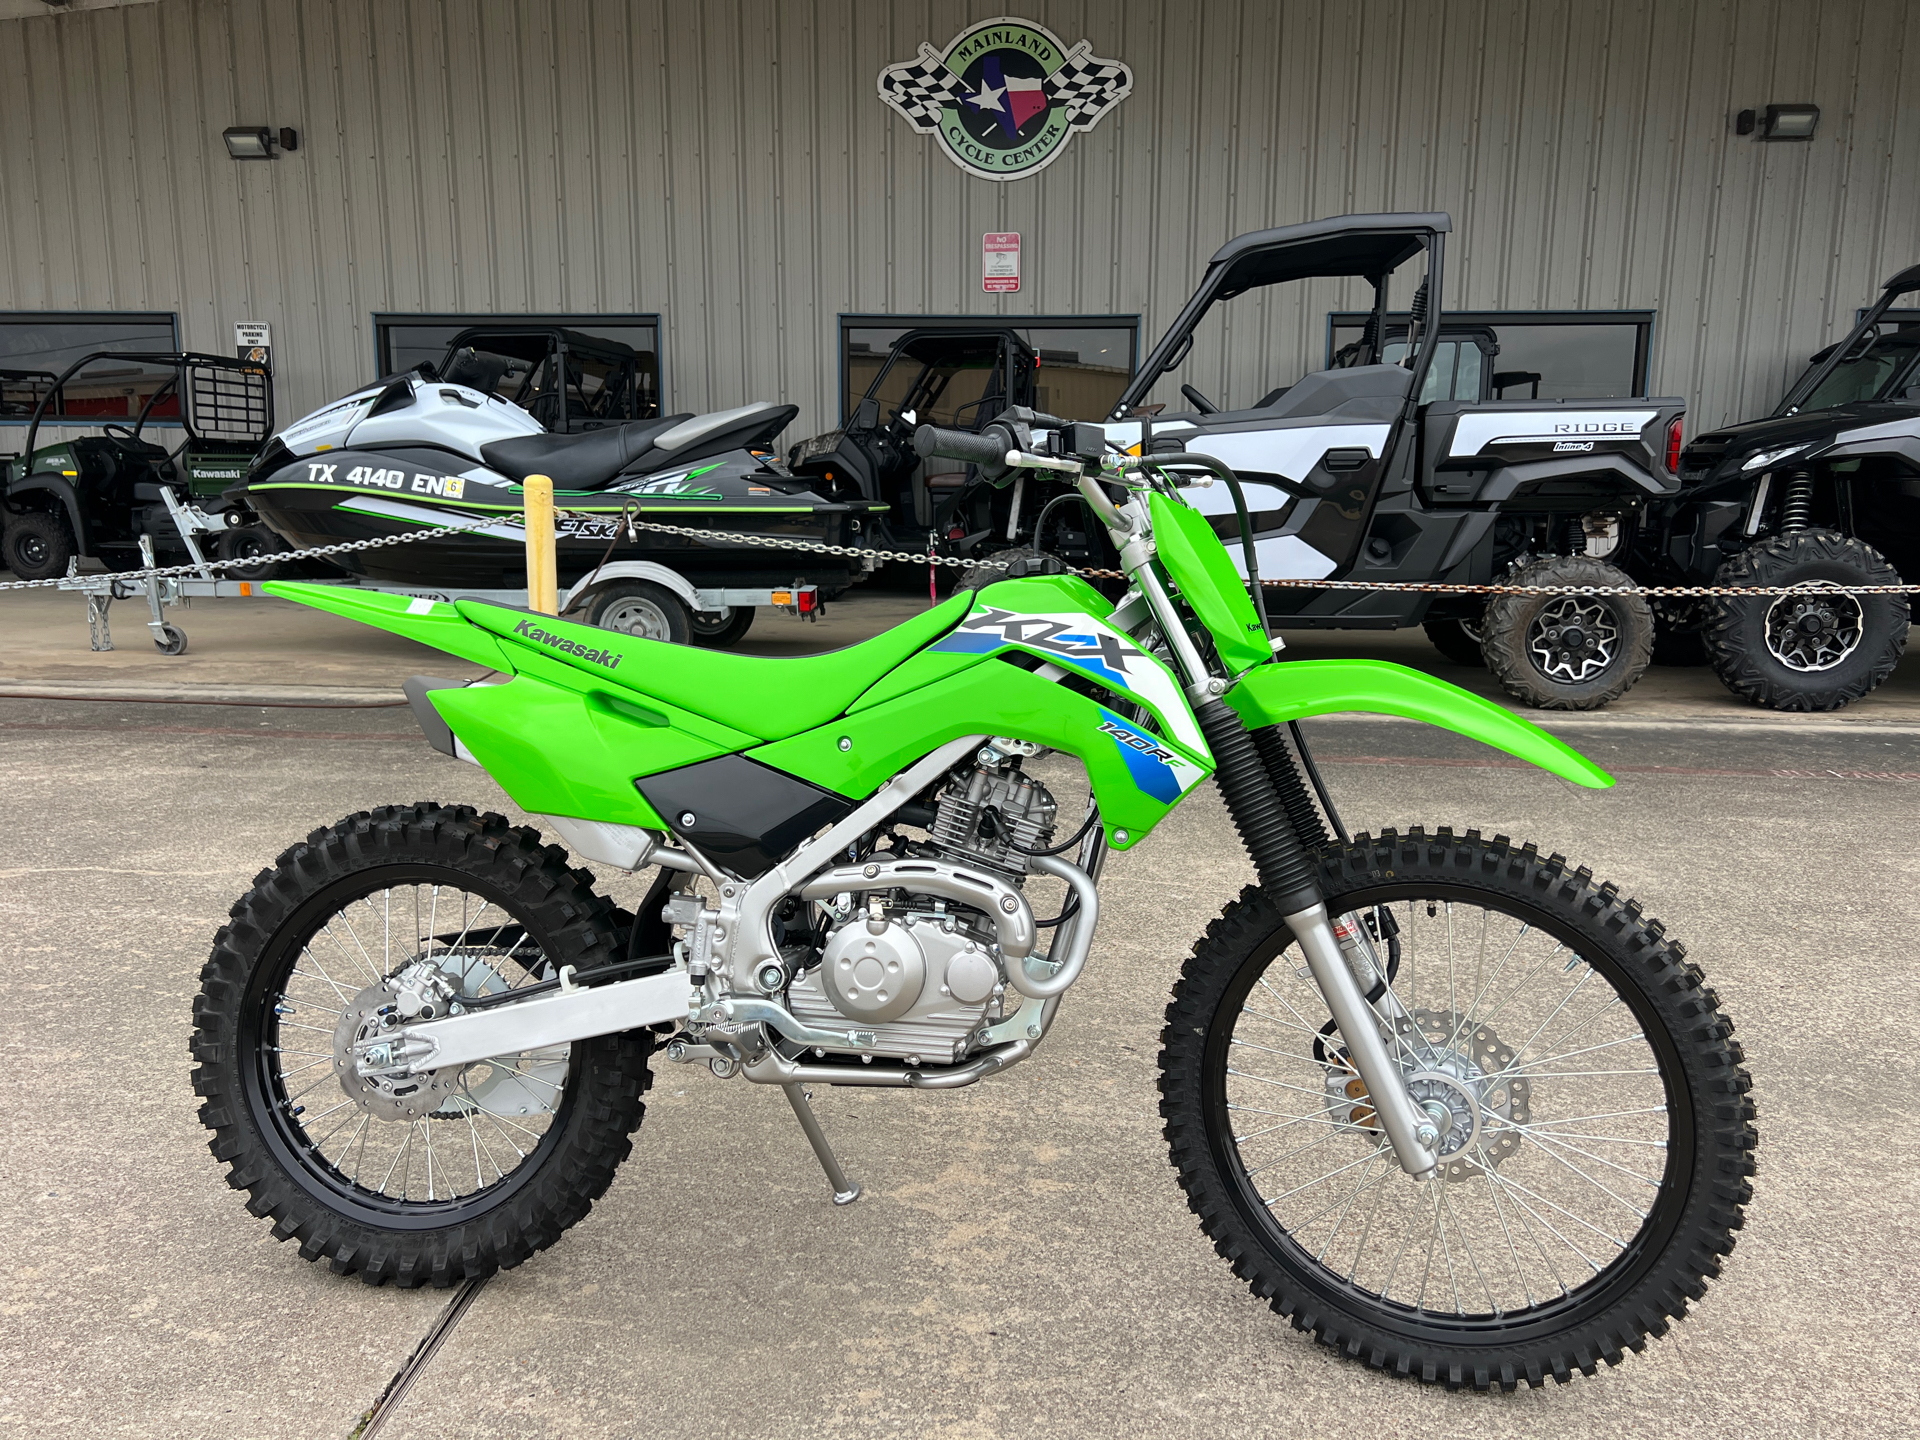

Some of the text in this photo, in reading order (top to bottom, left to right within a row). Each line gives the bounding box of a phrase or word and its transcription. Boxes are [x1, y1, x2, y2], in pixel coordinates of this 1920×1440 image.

[958, 31, 1051, 62] MAINLAND
[949, 124, 1060, 166] CYCLE CENTER
[1554, 422, 1634, 433] RIDGE
[193, 469, 240, 479] Kawasaki
[308, 463, 445, 496] TX 4140 EN
[450, 481, 457, 492] 6
[513, 619, 623, 670] Kawasaki
[961, 607, 1148, 675] KLX
